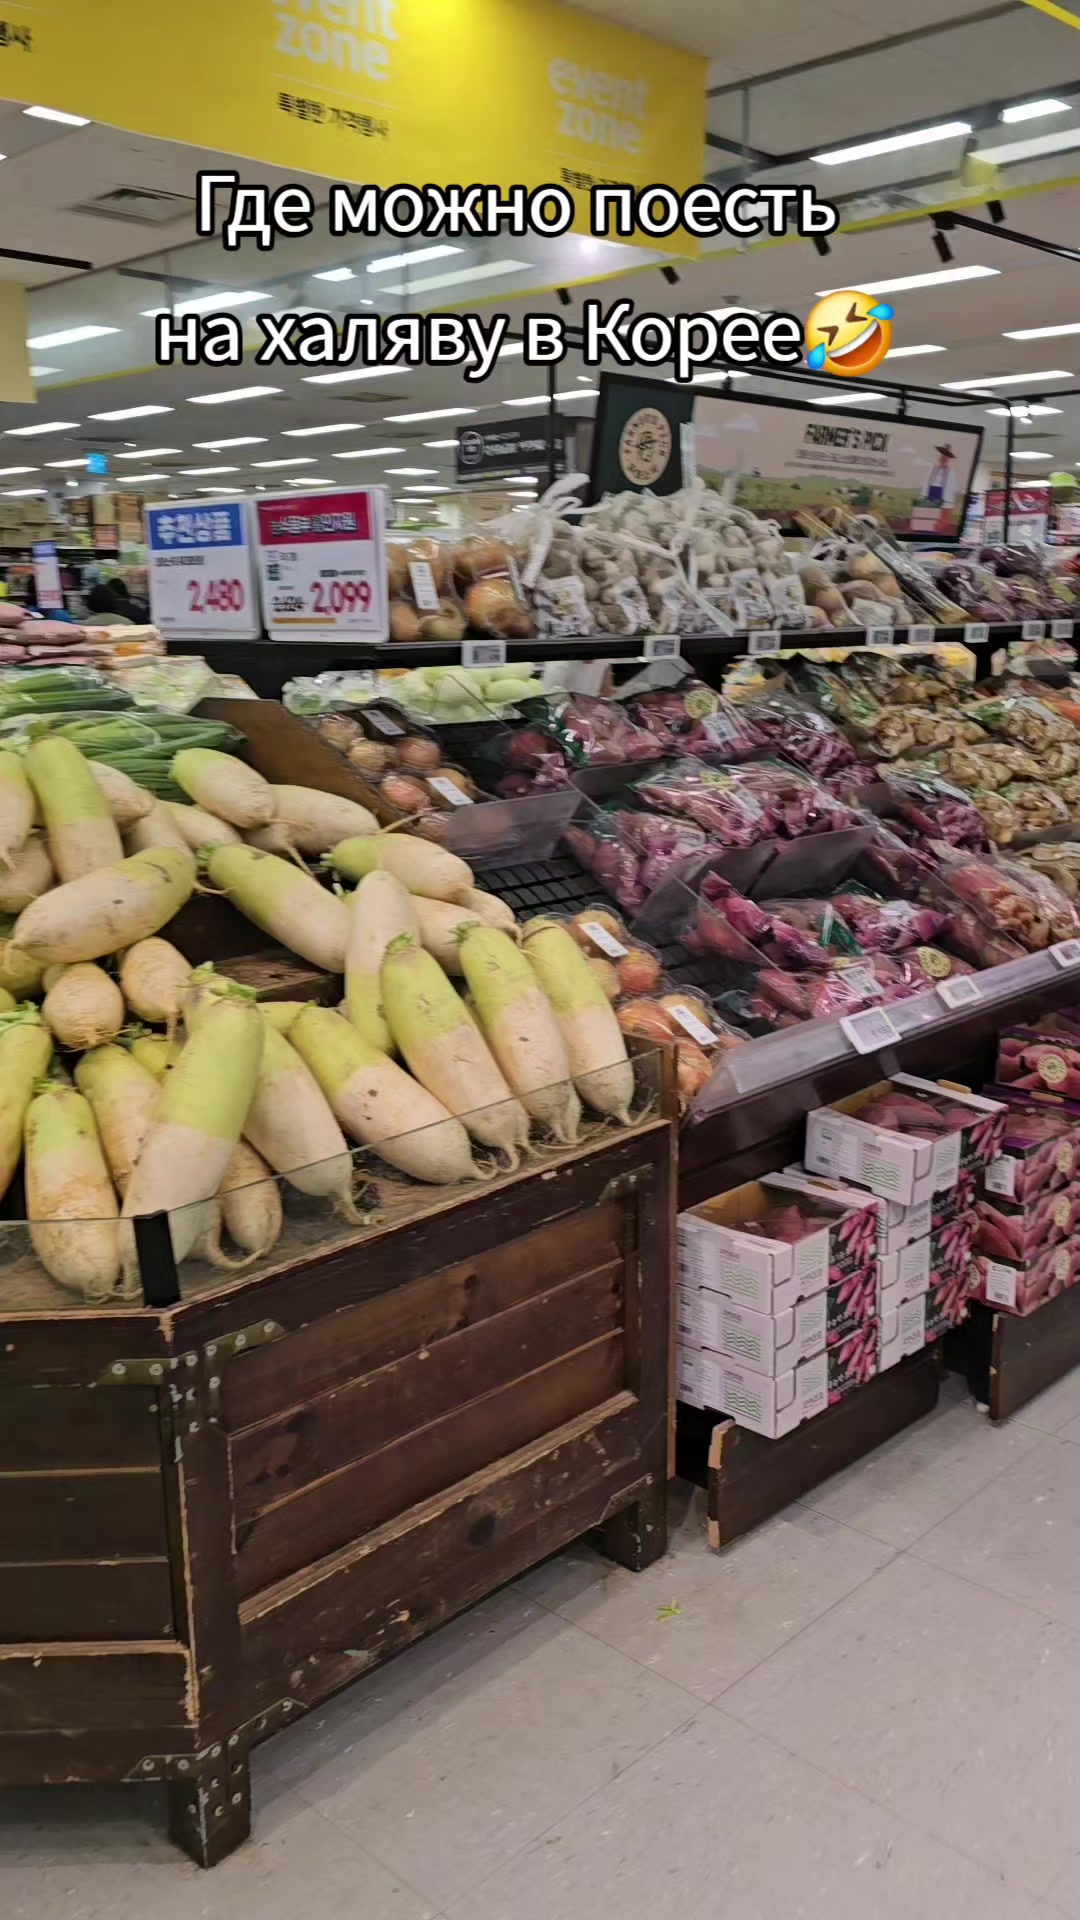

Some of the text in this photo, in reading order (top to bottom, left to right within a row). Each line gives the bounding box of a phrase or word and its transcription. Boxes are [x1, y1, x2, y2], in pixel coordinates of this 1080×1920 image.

[274, 11, 389, 82] zone
[548, 57, 648, 119] event
[277, 92, 325, 124] 특별한
[558, 99, 641, 155] zone
[156, 511, 232, 545] 추천상품
[187, 579, 245, 613] 2,480
[310, 581, 372, 615] 2,099
